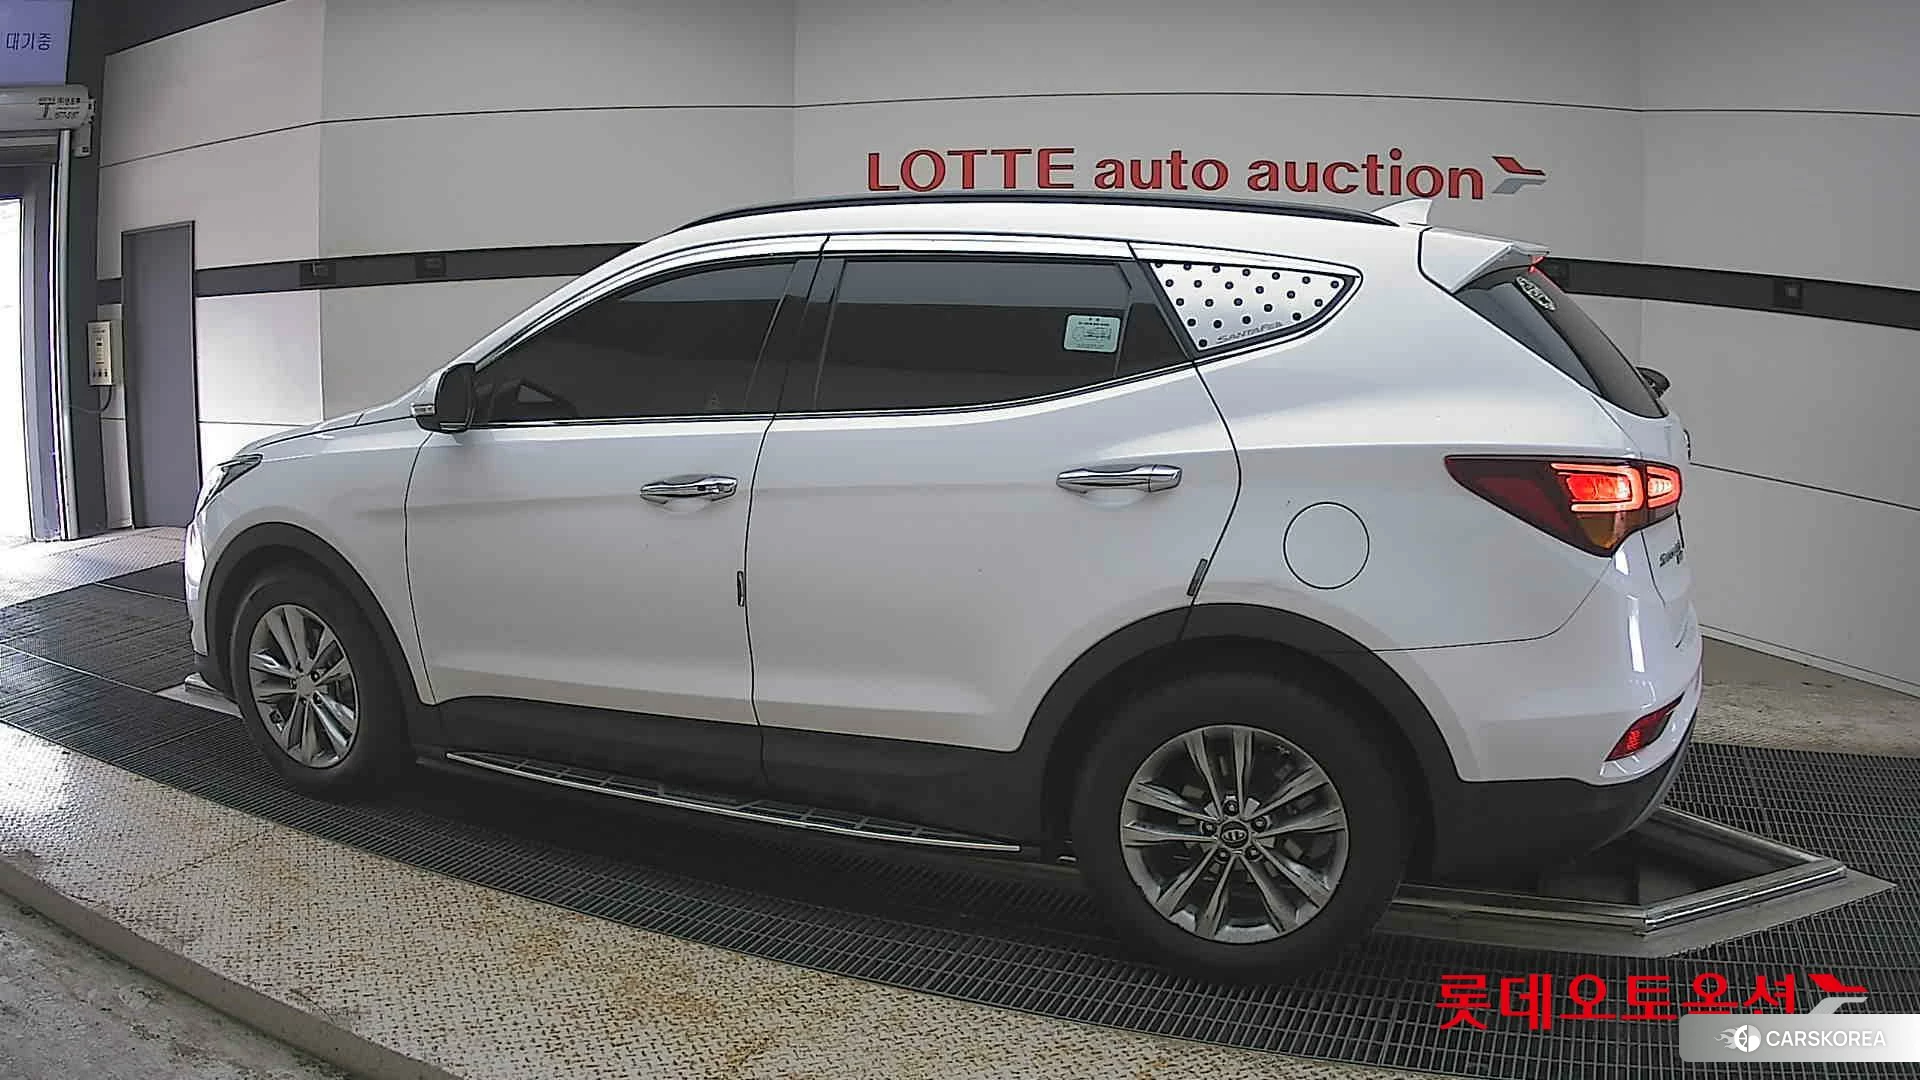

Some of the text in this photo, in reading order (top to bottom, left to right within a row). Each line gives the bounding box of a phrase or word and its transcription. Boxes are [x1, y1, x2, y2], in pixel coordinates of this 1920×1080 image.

[6, 31, 52, 51] 대기중
[866, 148, 1485, 200] LOTTE auto auction
